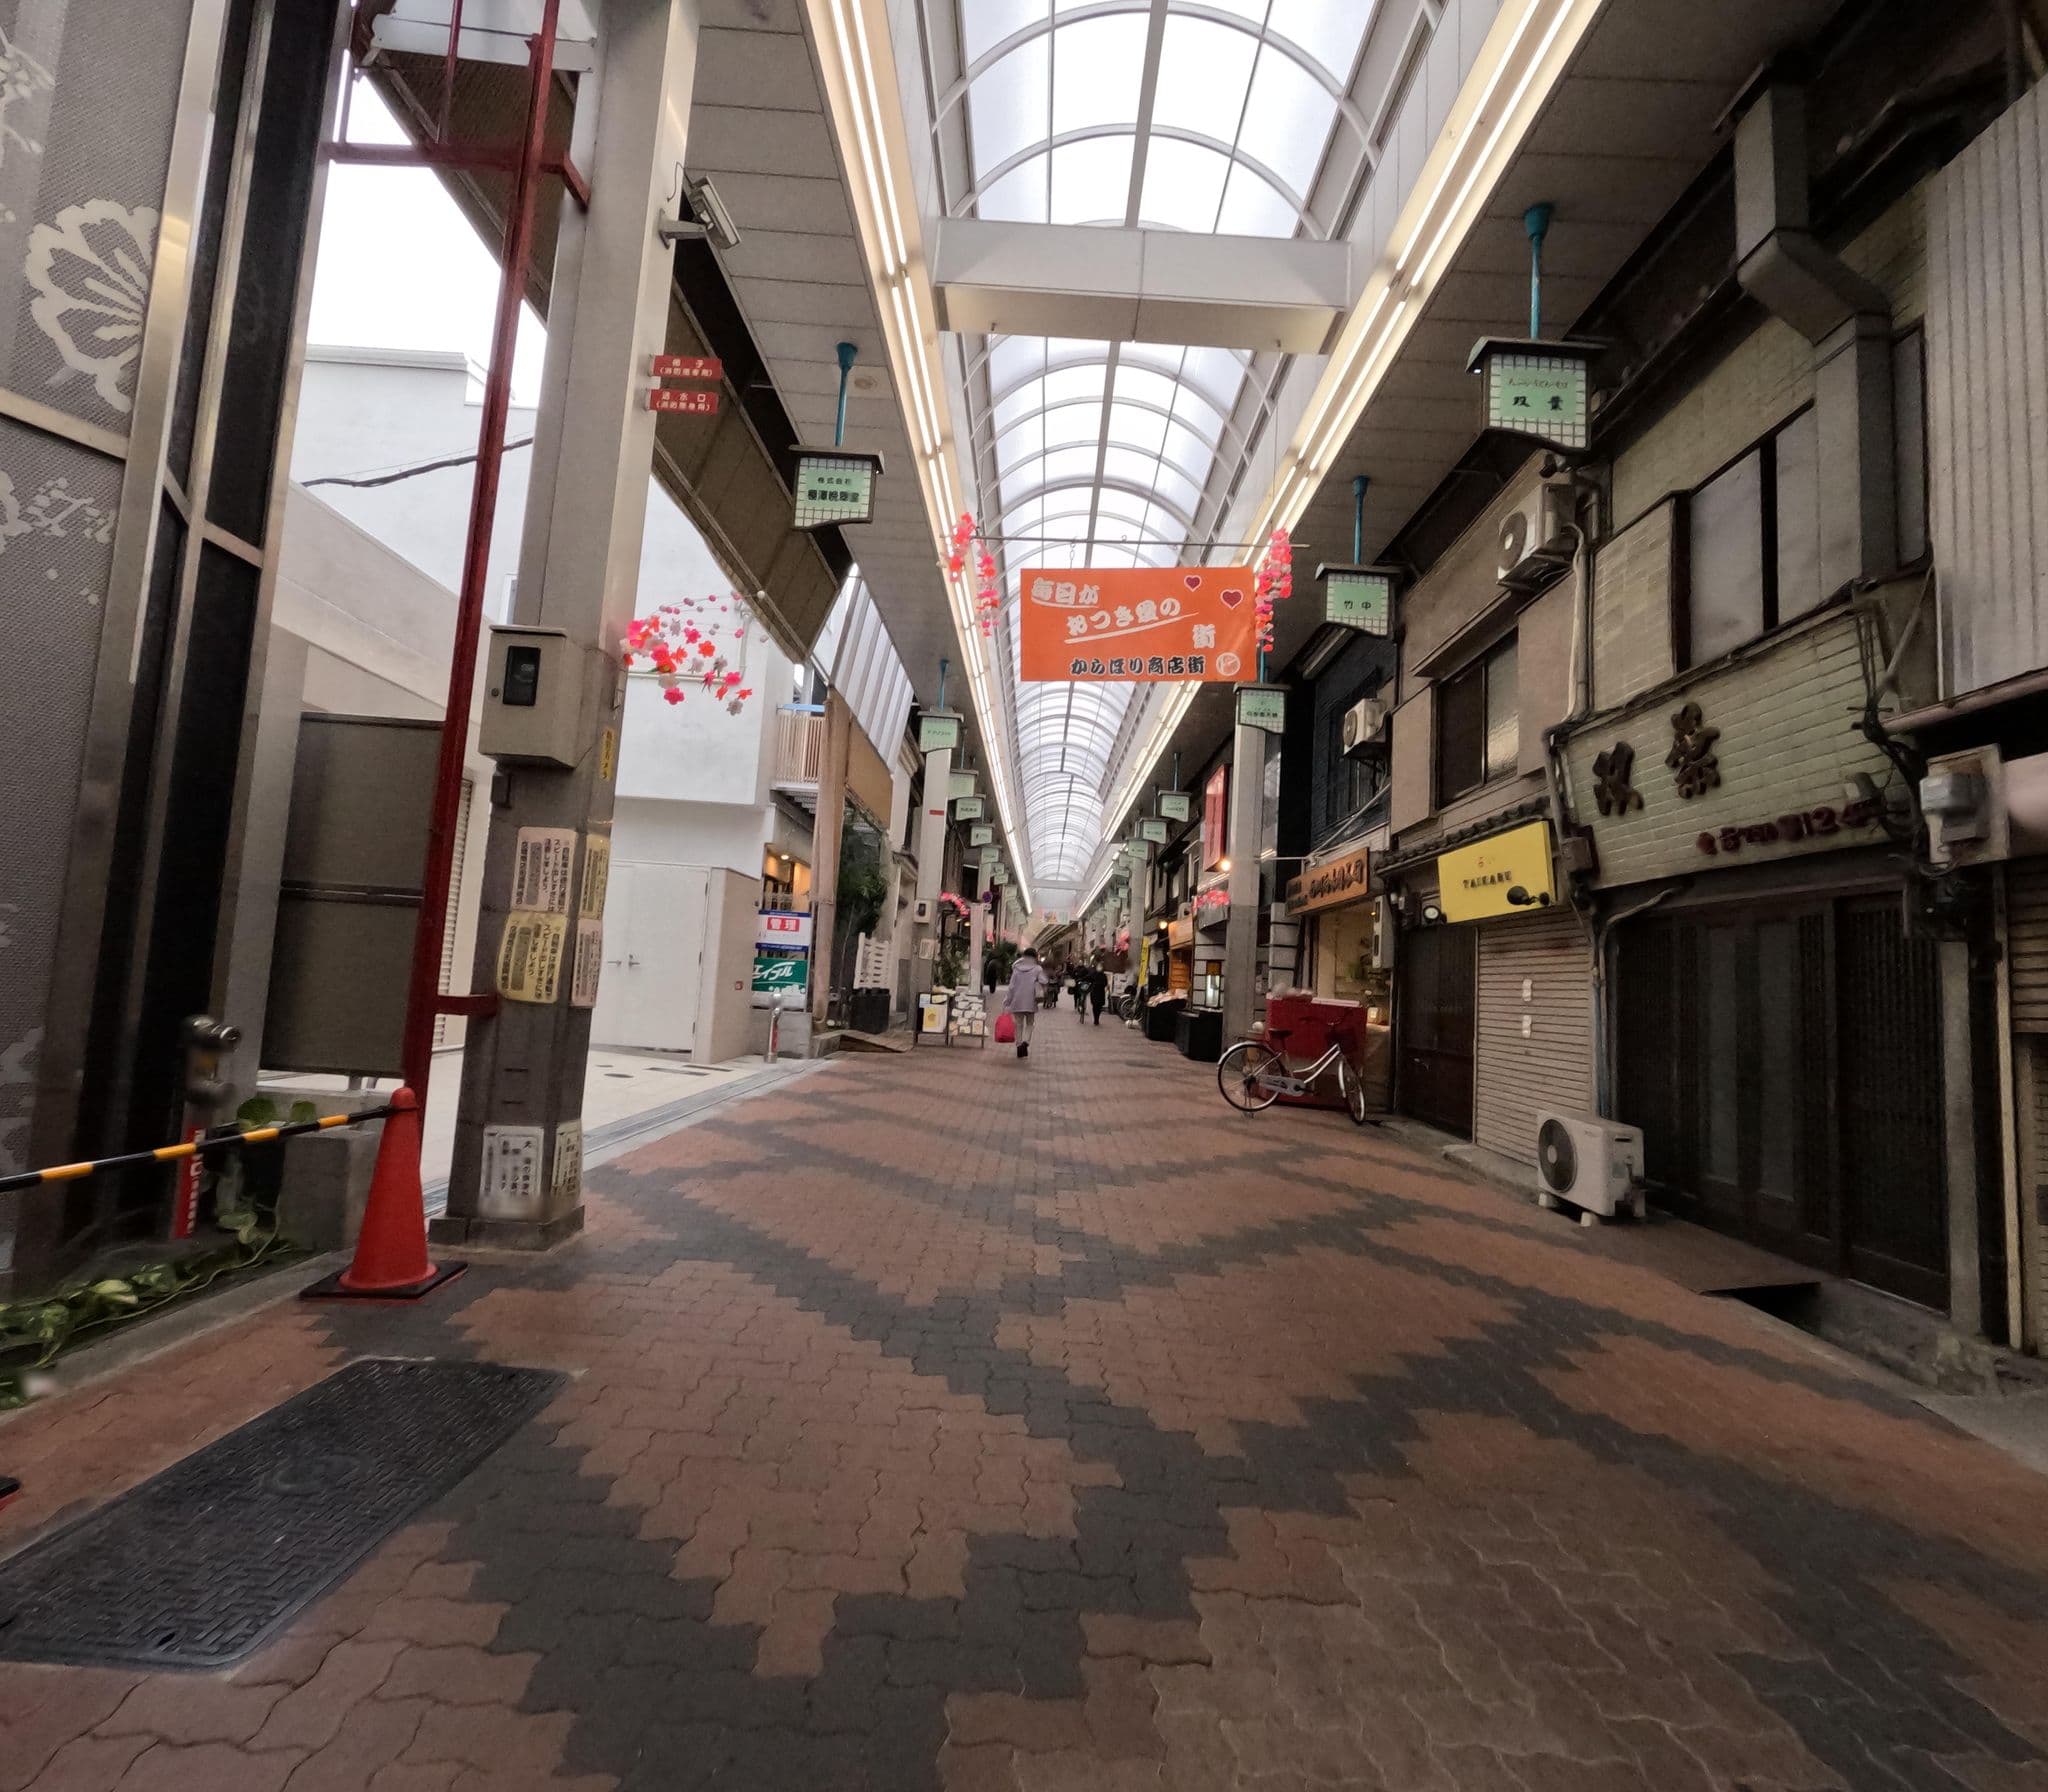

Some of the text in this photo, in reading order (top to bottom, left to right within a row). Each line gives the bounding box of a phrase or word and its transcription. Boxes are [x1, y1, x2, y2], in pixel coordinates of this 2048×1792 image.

[1031, 577, 1099, 605] 毎日が
[1192, 623, 1216, 649] 街
[1070, 656, 1206, 676] からほり商店街
